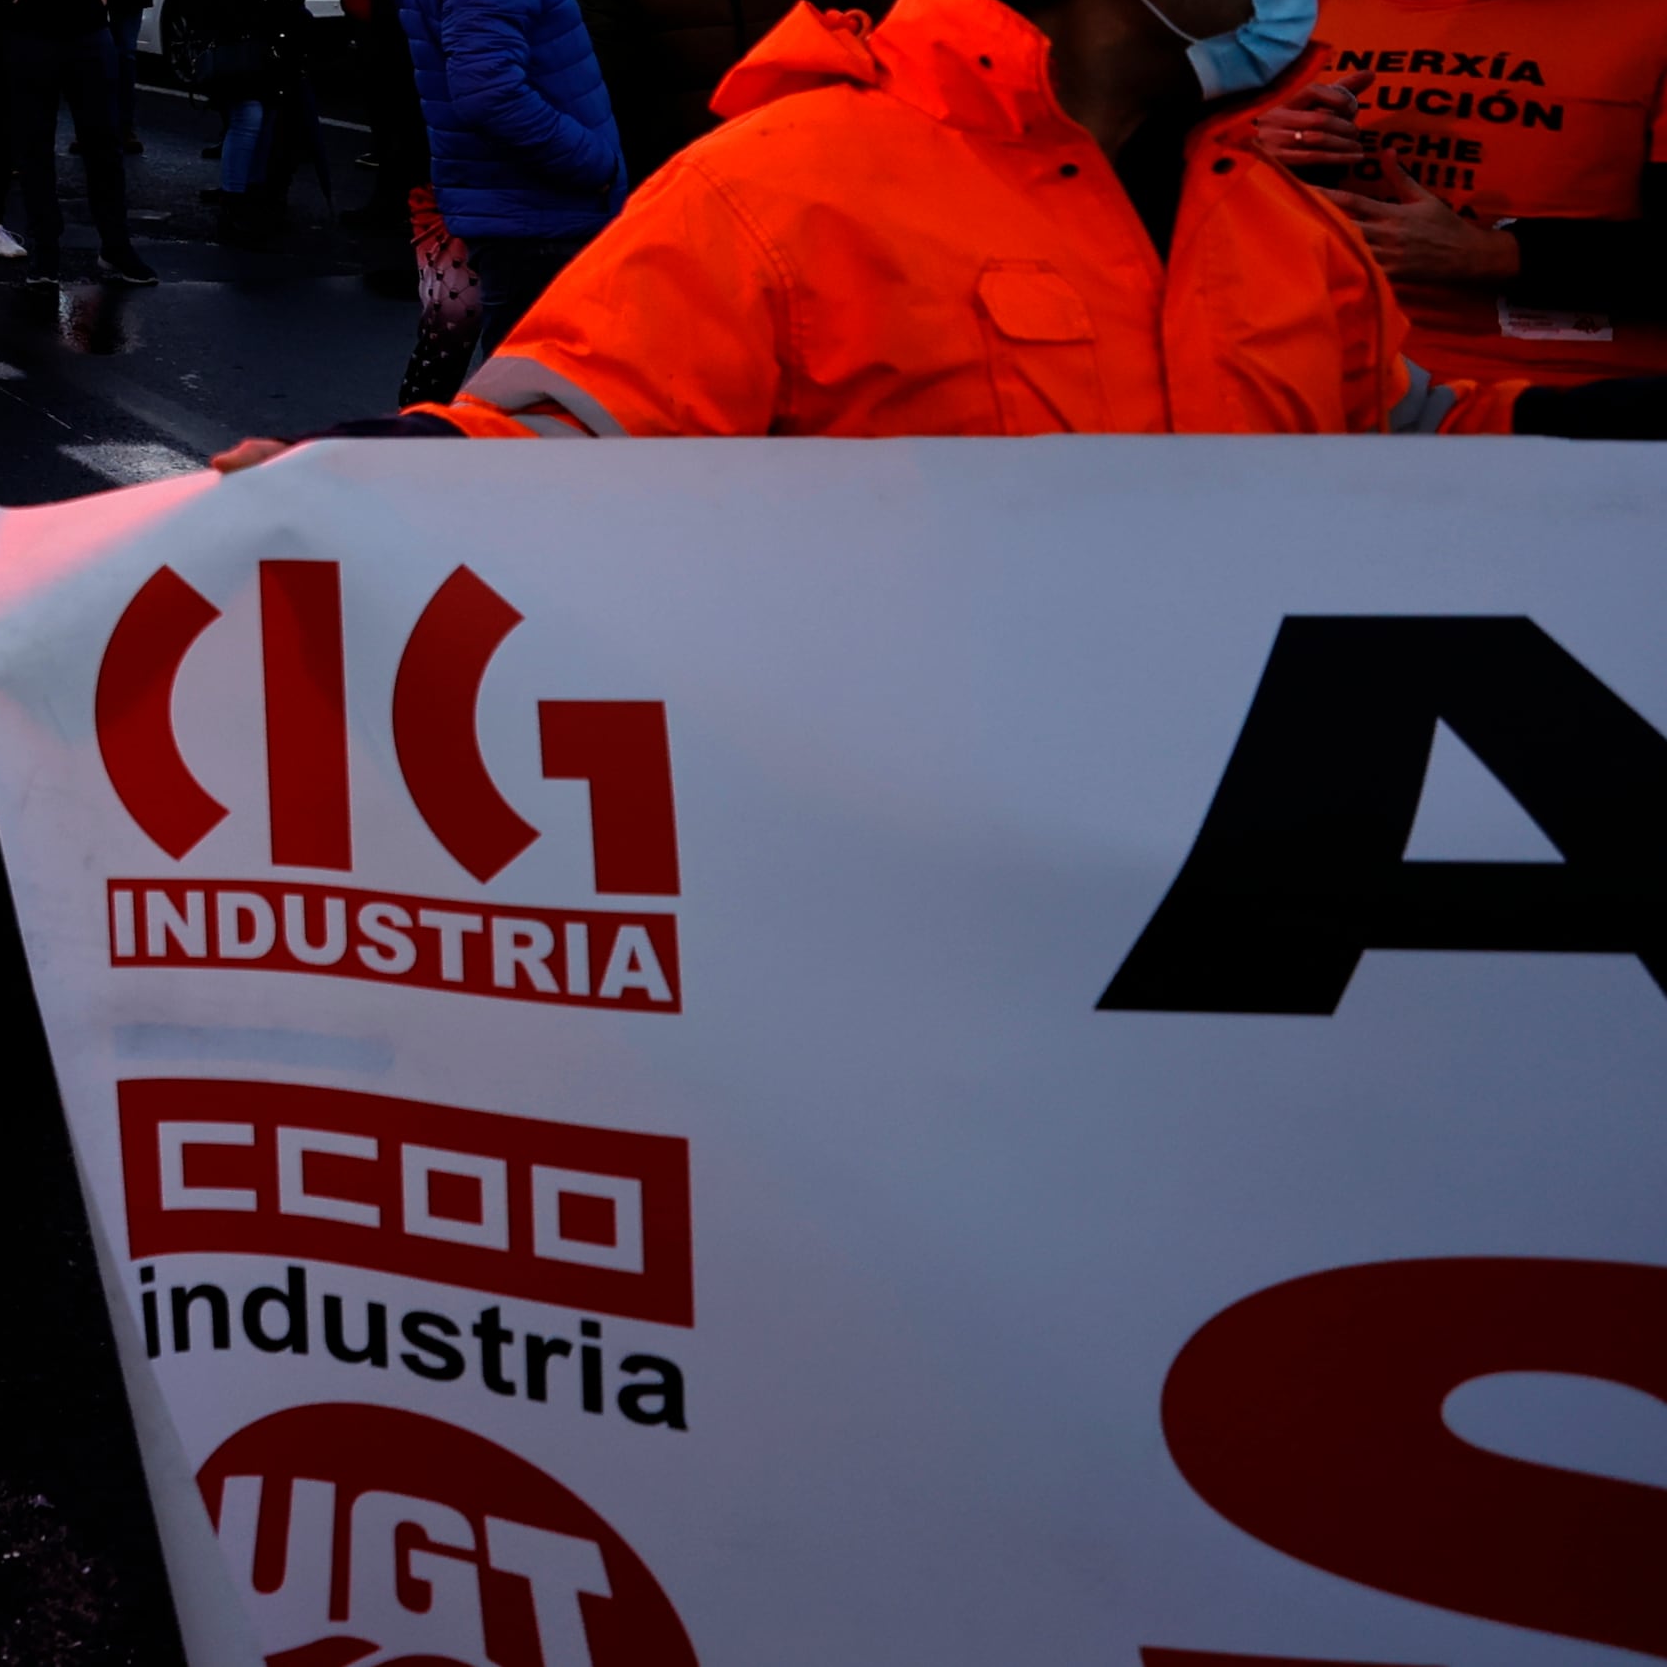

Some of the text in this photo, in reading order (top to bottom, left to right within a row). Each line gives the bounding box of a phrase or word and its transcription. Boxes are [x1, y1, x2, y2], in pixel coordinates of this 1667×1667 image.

[1323, 50, 1545, 86] NERXÍA
[94, 559, 681, 896] CIG
[112, 889, 672, 1003] INDUSTRIA
[157, 1120, 644, 1274] CCOO
[139, 1266, 689, 1432] industria
[217, 1474, 614, 1667] UGT
